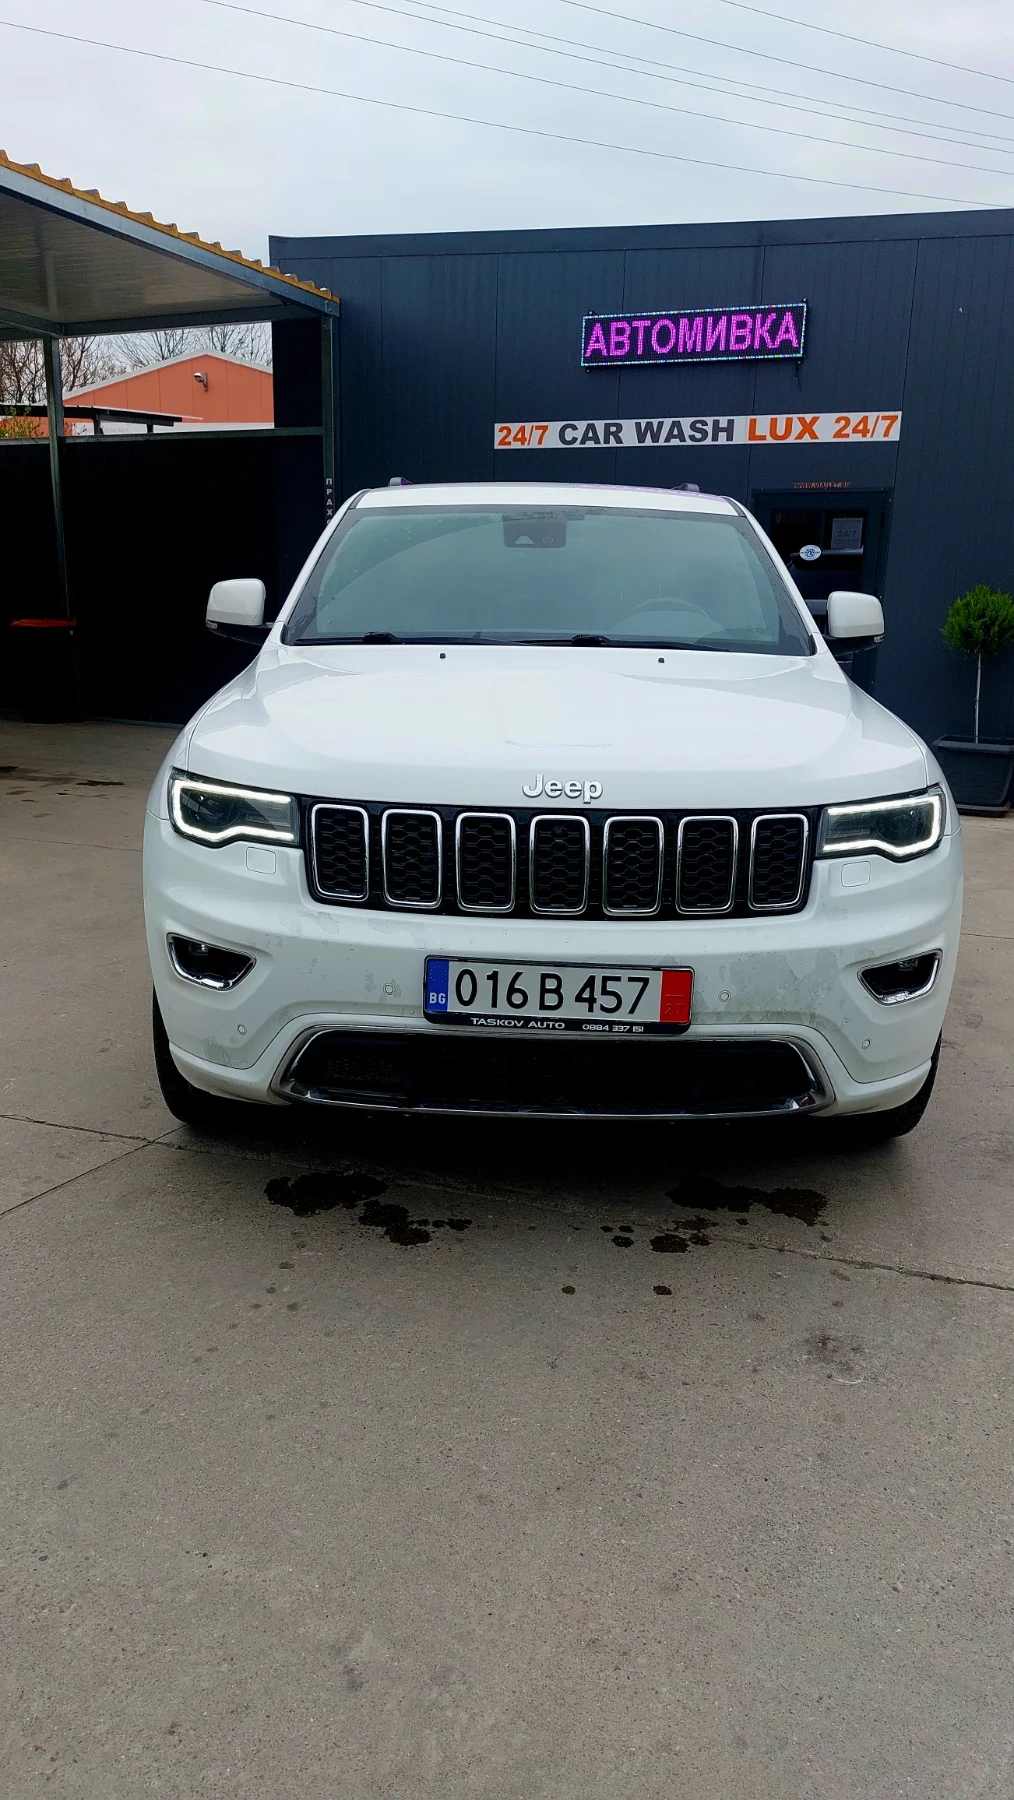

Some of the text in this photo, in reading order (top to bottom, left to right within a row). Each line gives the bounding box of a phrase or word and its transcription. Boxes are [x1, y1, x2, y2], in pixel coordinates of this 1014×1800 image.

[585, 311, 799, 357] АВТОМИВКА
[497, 414, 899, 447] 24/7 CAR WASH LUX 24/7
[522, 773, 604, 805] Jeep
[429, 992, 446, 1005] BG
[470, 1017, 524, 1028] TASKOV
[527, 1020, 566, 1030] AUTO
[582, 1023, 610, 1032] 0884
[611, 1024, 630, 1033] 337
